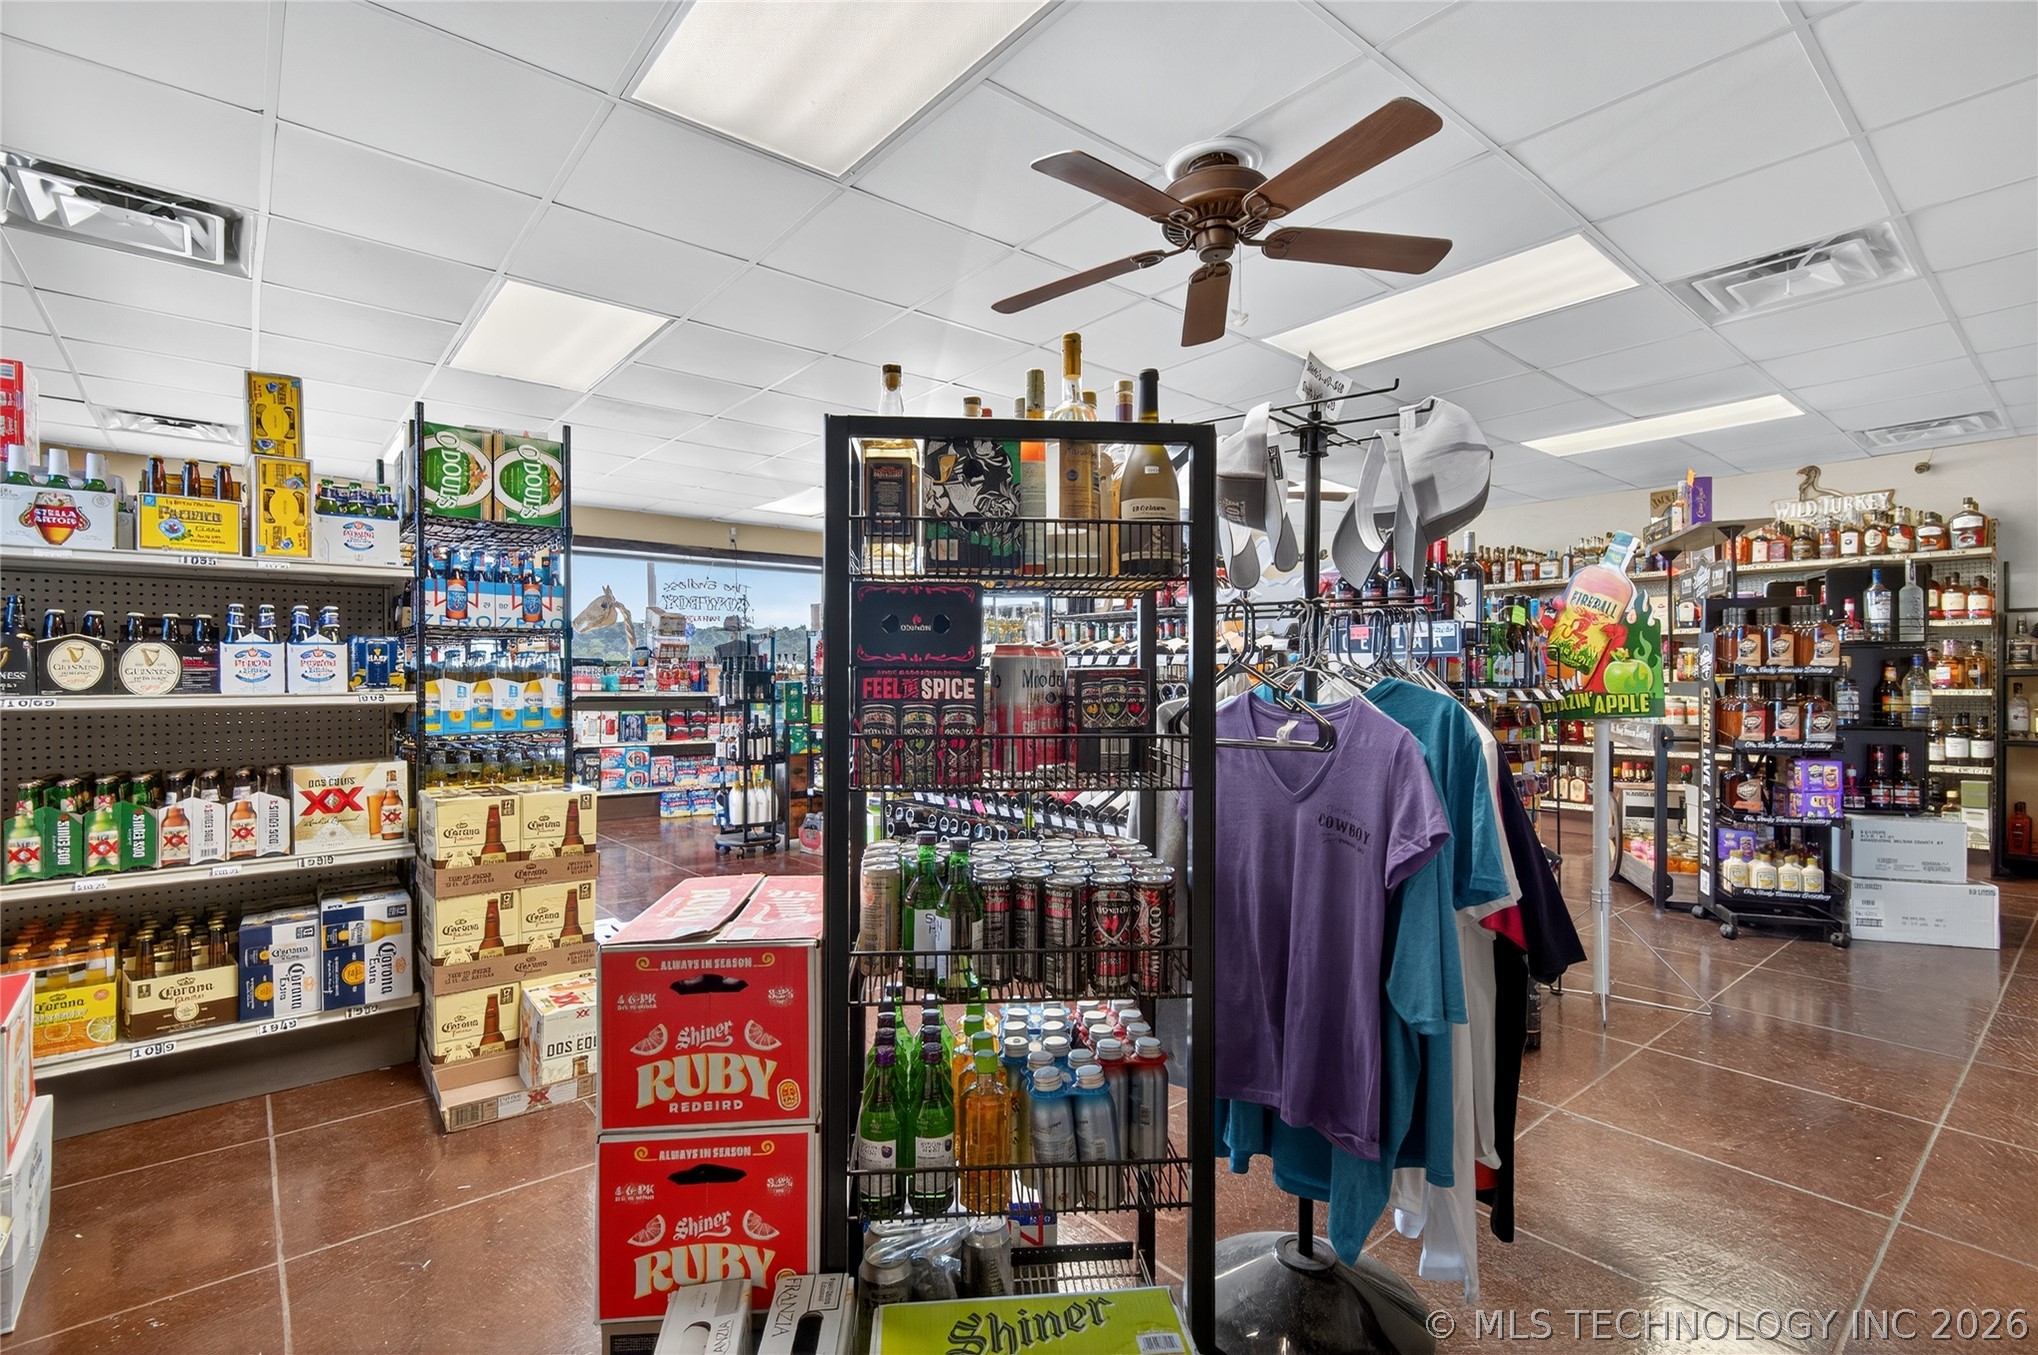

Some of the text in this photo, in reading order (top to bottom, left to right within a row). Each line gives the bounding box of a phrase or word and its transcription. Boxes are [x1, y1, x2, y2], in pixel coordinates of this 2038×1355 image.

[34, 507, 77, 518] STELLA
[1774, 491, 1891, 519] WILD TURKEY
[1570, 590, 1619, 619] FIREBALL
[124, 667, 176, 676] GUINNESS
[862, 677, 902, 699] FEEL
[921, 677, 976, 700] SPICE
[1594, 692, 1650, 714] APPLE
[1702, 748, 1712, 786] LIVE
[1703, 790, 1711, 802] A
[443, 827, 481, 839] Corona
[527, 820, 561, 832] Corona
[1318, 812, 1371, 845] COWBOY
[1702, 804, 1712, 867] LITTLE
[525, 911, 560, 923] Corona
[442, 924, 479, 936] Corona
[378, 941, 397, 995] Corona
[660, 957, 753, 971] ALWAYS IN SEASON
[158, 982, 215, 1000] Corona
[287, 963, 305, 1010] Corona
[34, 998, 86, 1014] Corona
[675, 1020, 734, 1050] Shiner
[547, 1041, 573, 1057] DOS
[636, 1053, 778, 1109] RUBY
[669, 1100, 744, 1113] REDBIRD
[659, 1145, 752, 1161] ALWAYS IN SEASON
[673, 1210, 733, 1240] Shiner
[634, 1243, 777, 1299] RUBY
[771, 1277, 802, 1338] FRANZIA
[945, 1295, 1117, 1355] Shiner
